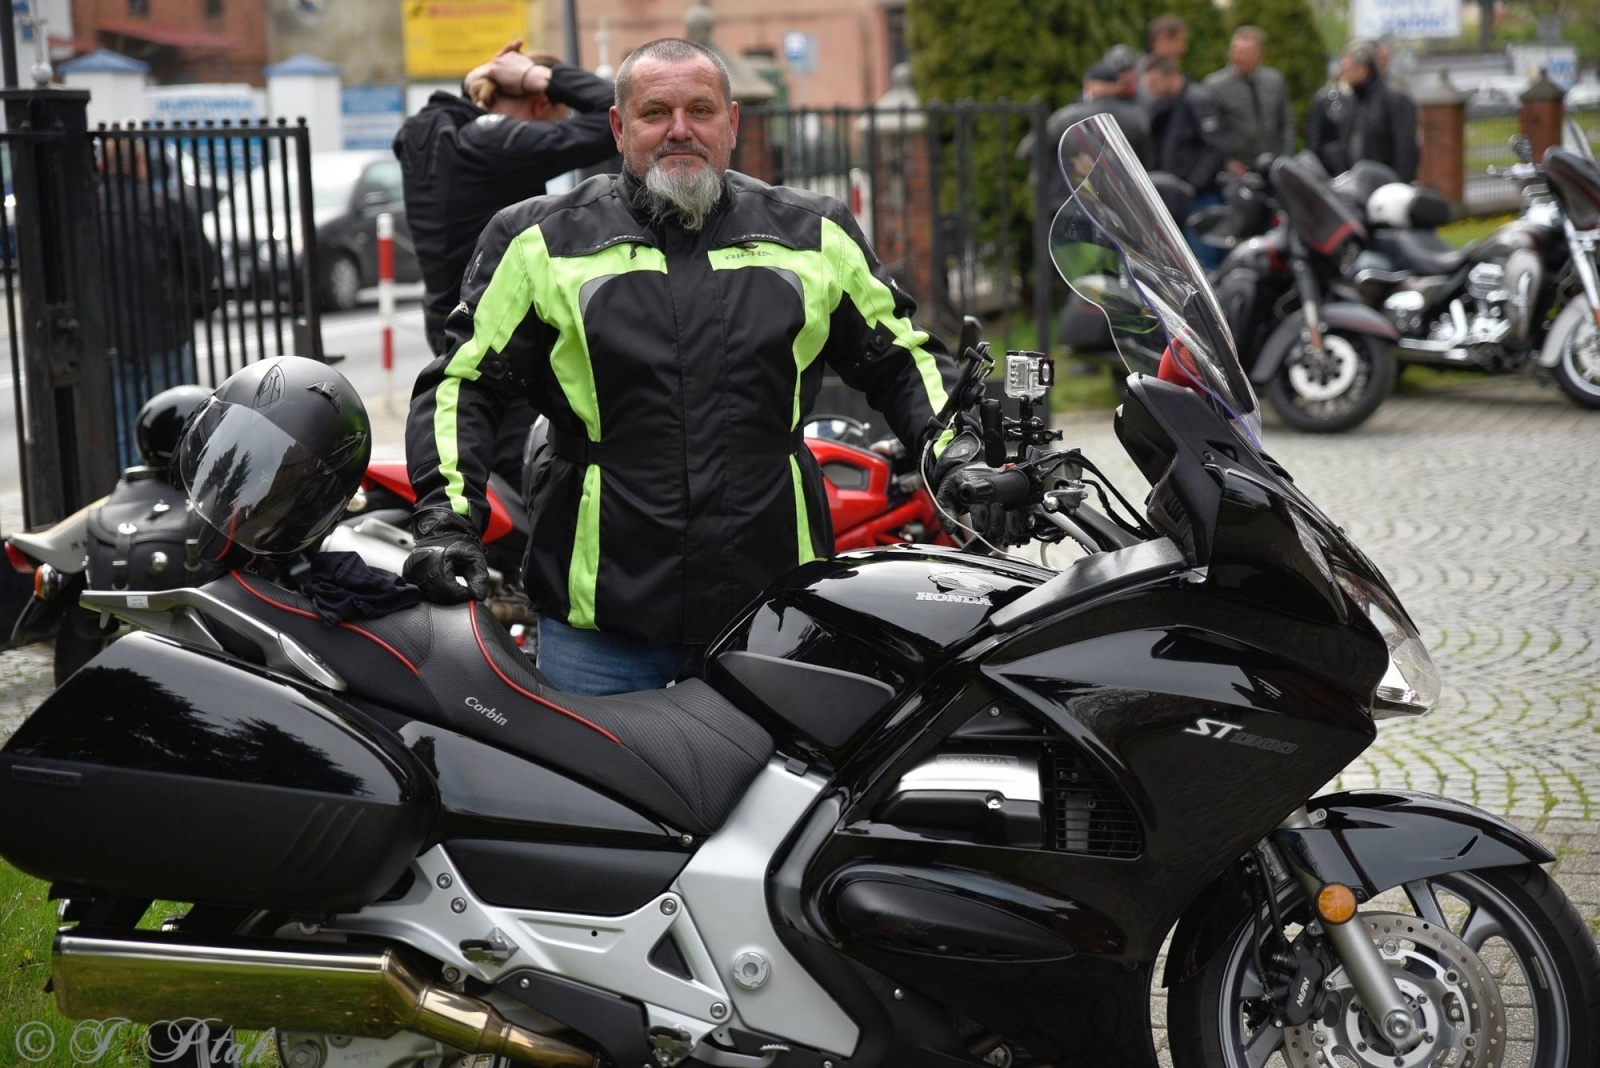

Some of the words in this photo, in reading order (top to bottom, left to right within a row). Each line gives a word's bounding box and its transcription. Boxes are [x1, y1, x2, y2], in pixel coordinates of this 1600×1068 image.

[916, 591, 994, 607] HONDA
[464, 696, 508, 726] Corbin
[1182, 718, 1245, 739] ST
